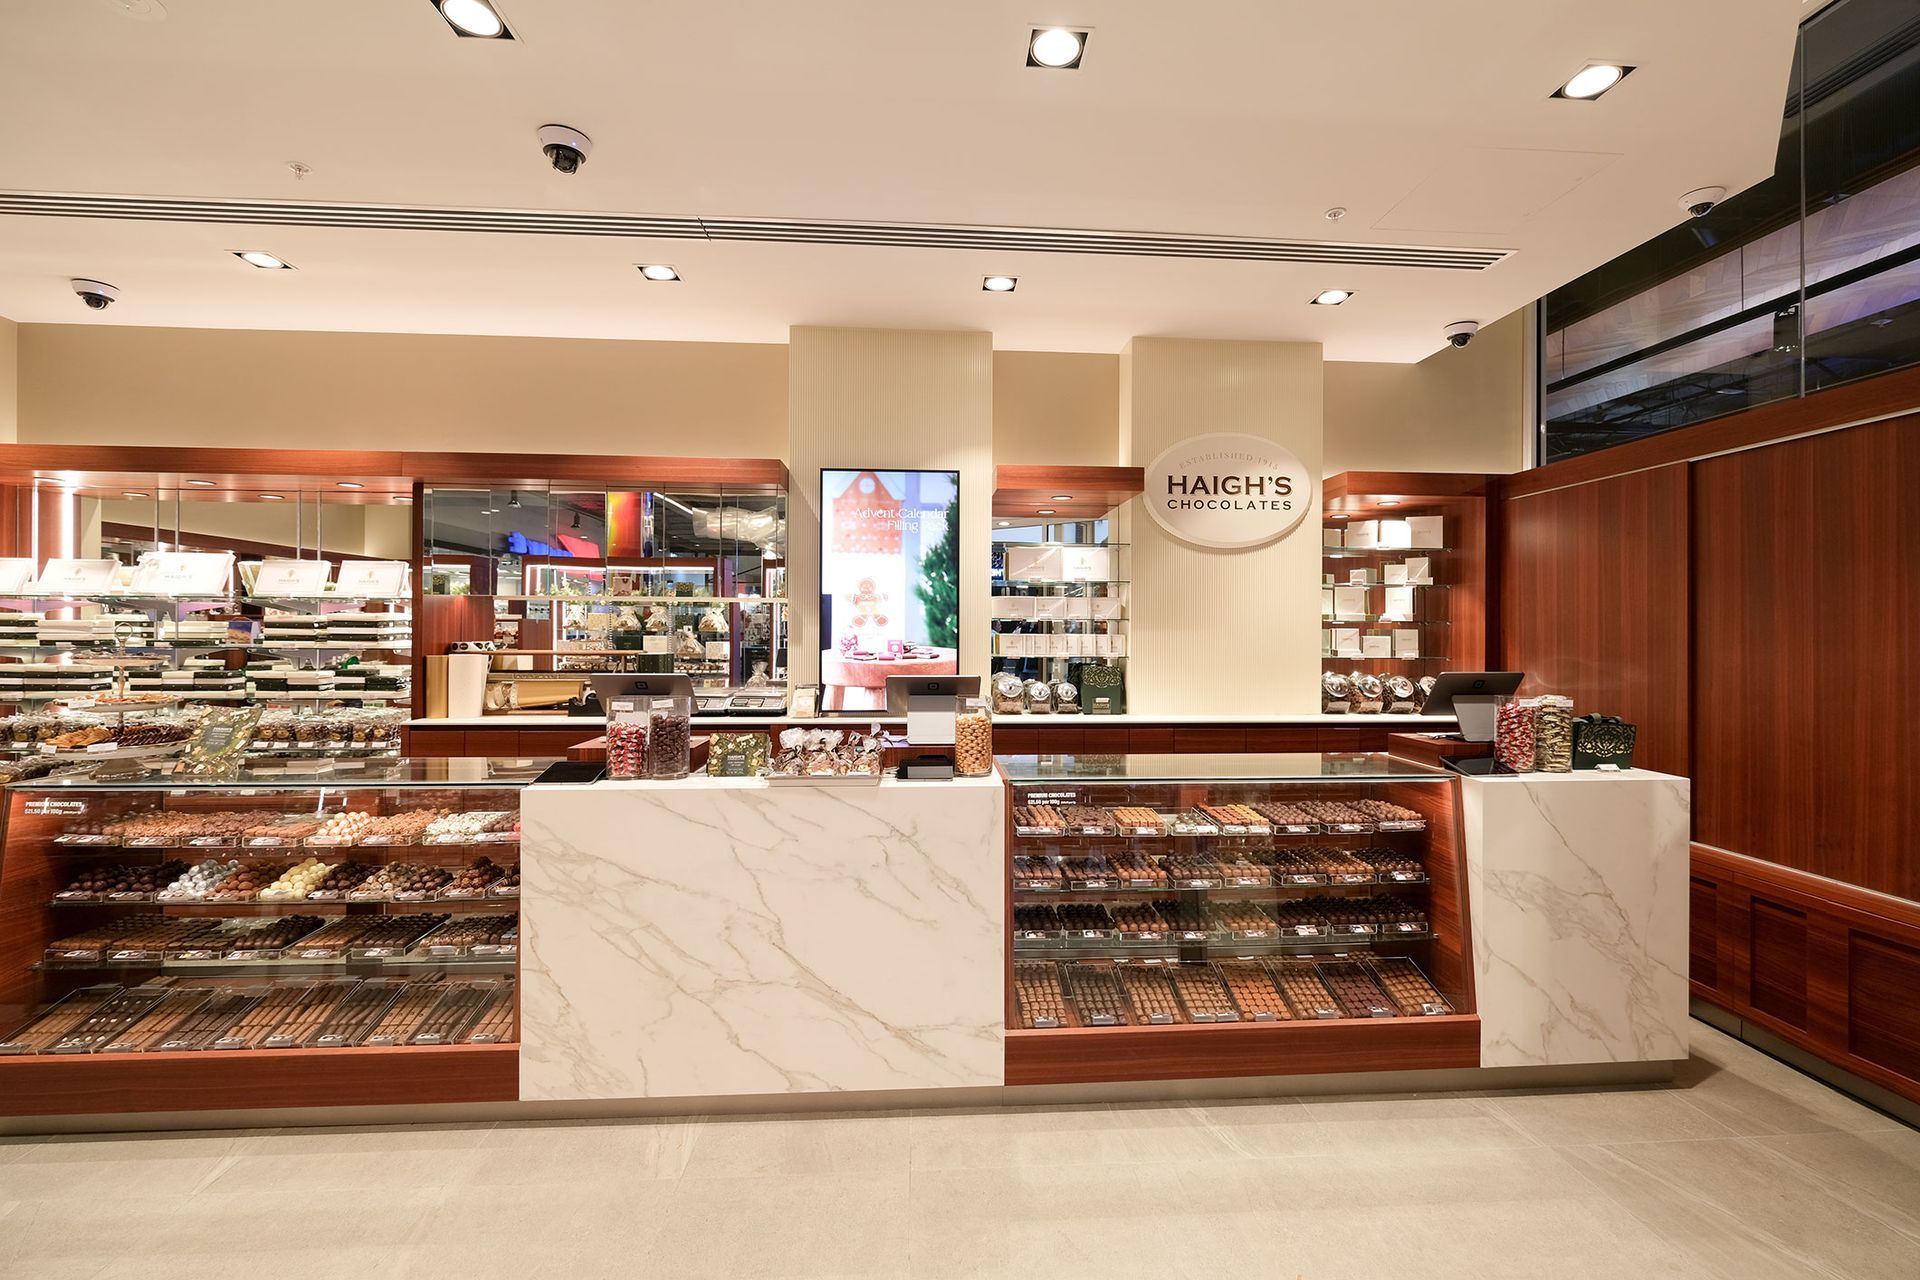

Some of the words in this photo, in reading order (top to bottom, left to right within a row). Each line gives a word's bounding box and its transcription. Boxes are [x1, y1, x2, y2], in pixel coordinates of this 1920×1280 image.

[1179, 452, 1253, 470] ESTABLISHED
[1167, 475, 1292, 496] HAIGH'S
[1167, 499, 1292, 511] CHOCOLATES
[855, 508, 895, 519] Advent
[899, 508, 949, 519] Calendar
[887, 520, 919, 533] Filling
